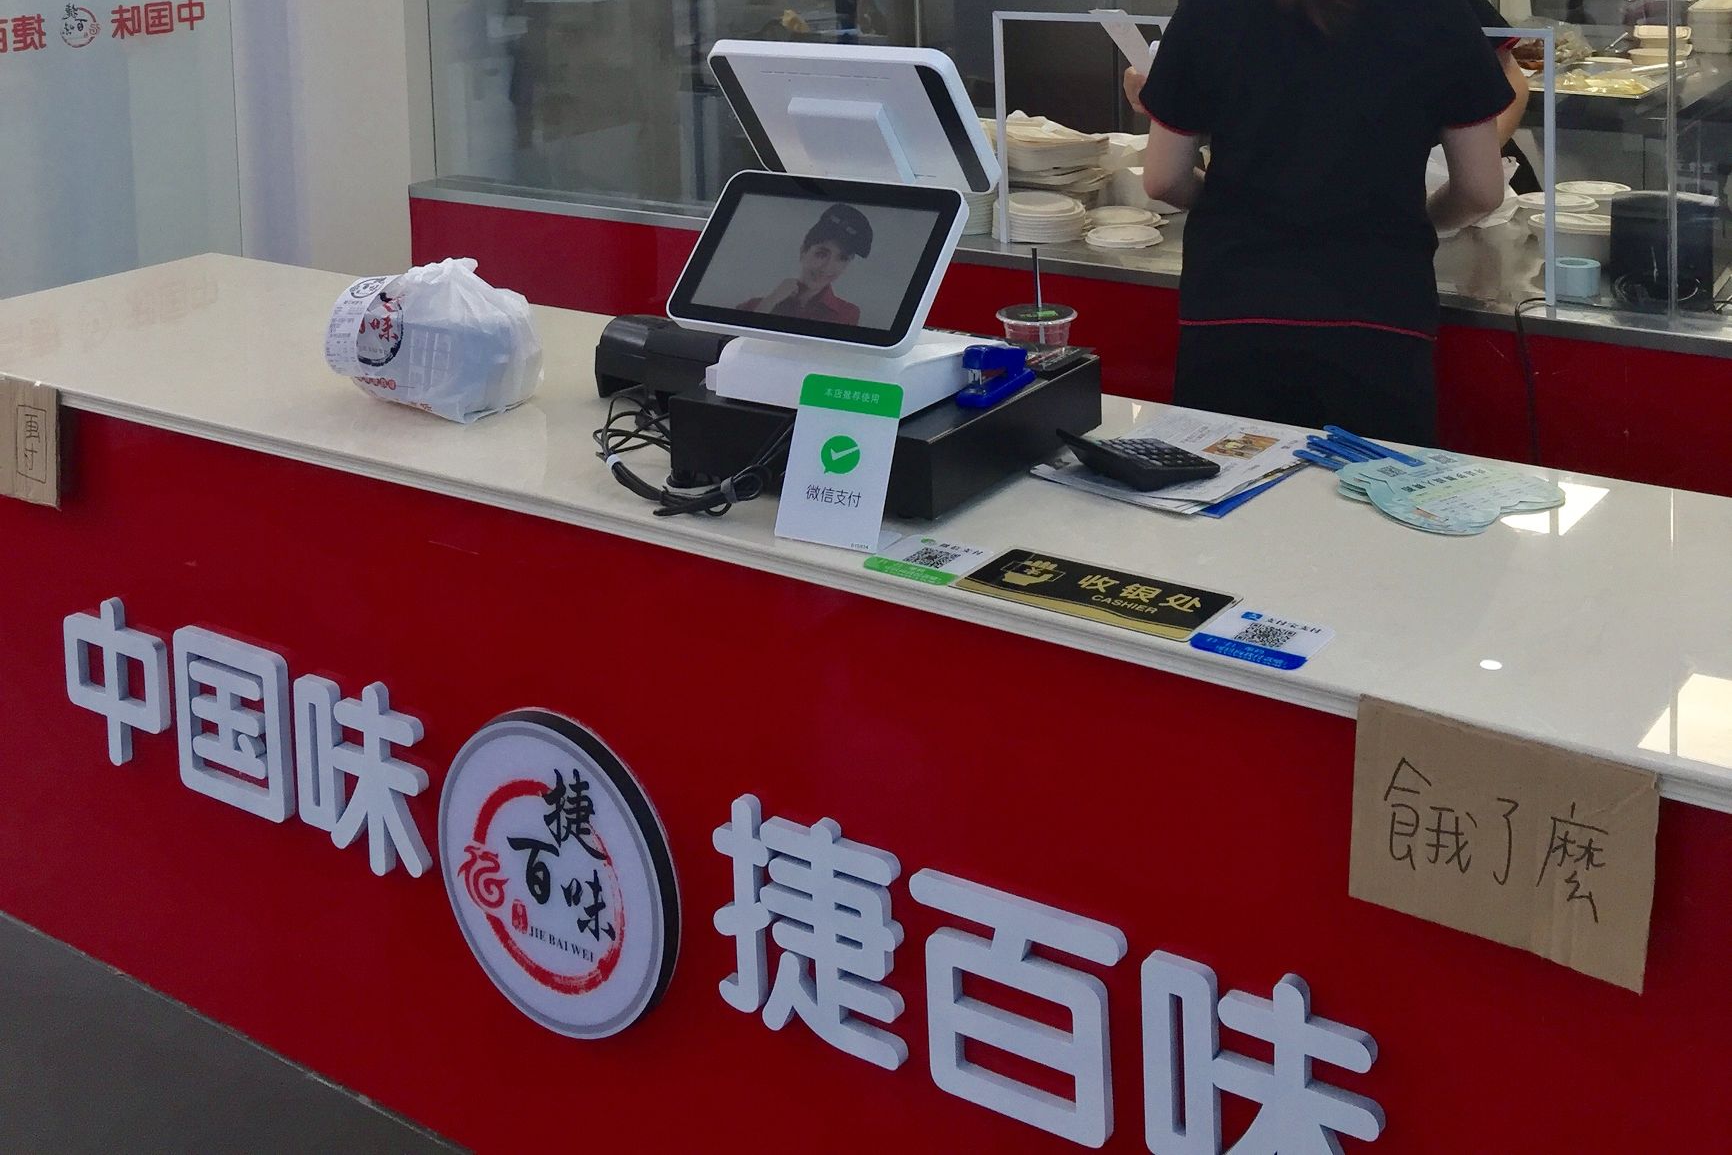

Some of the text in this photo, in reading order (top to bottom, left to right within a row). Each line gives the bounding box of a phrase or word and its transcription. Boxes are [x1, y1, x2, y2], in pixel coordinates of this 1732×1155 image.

[824, 387, 880, 404] 本店推荐使用
[805, 484, 862, 508] 微信支付
[1077, 574, 1201, 613] 收银处
[1091, 594, 1158, 614] CASHIER
[62, 597, 1388, 1155] 中国味 捷百味
[529, 925, 594, 963] JIE BAI WEI
